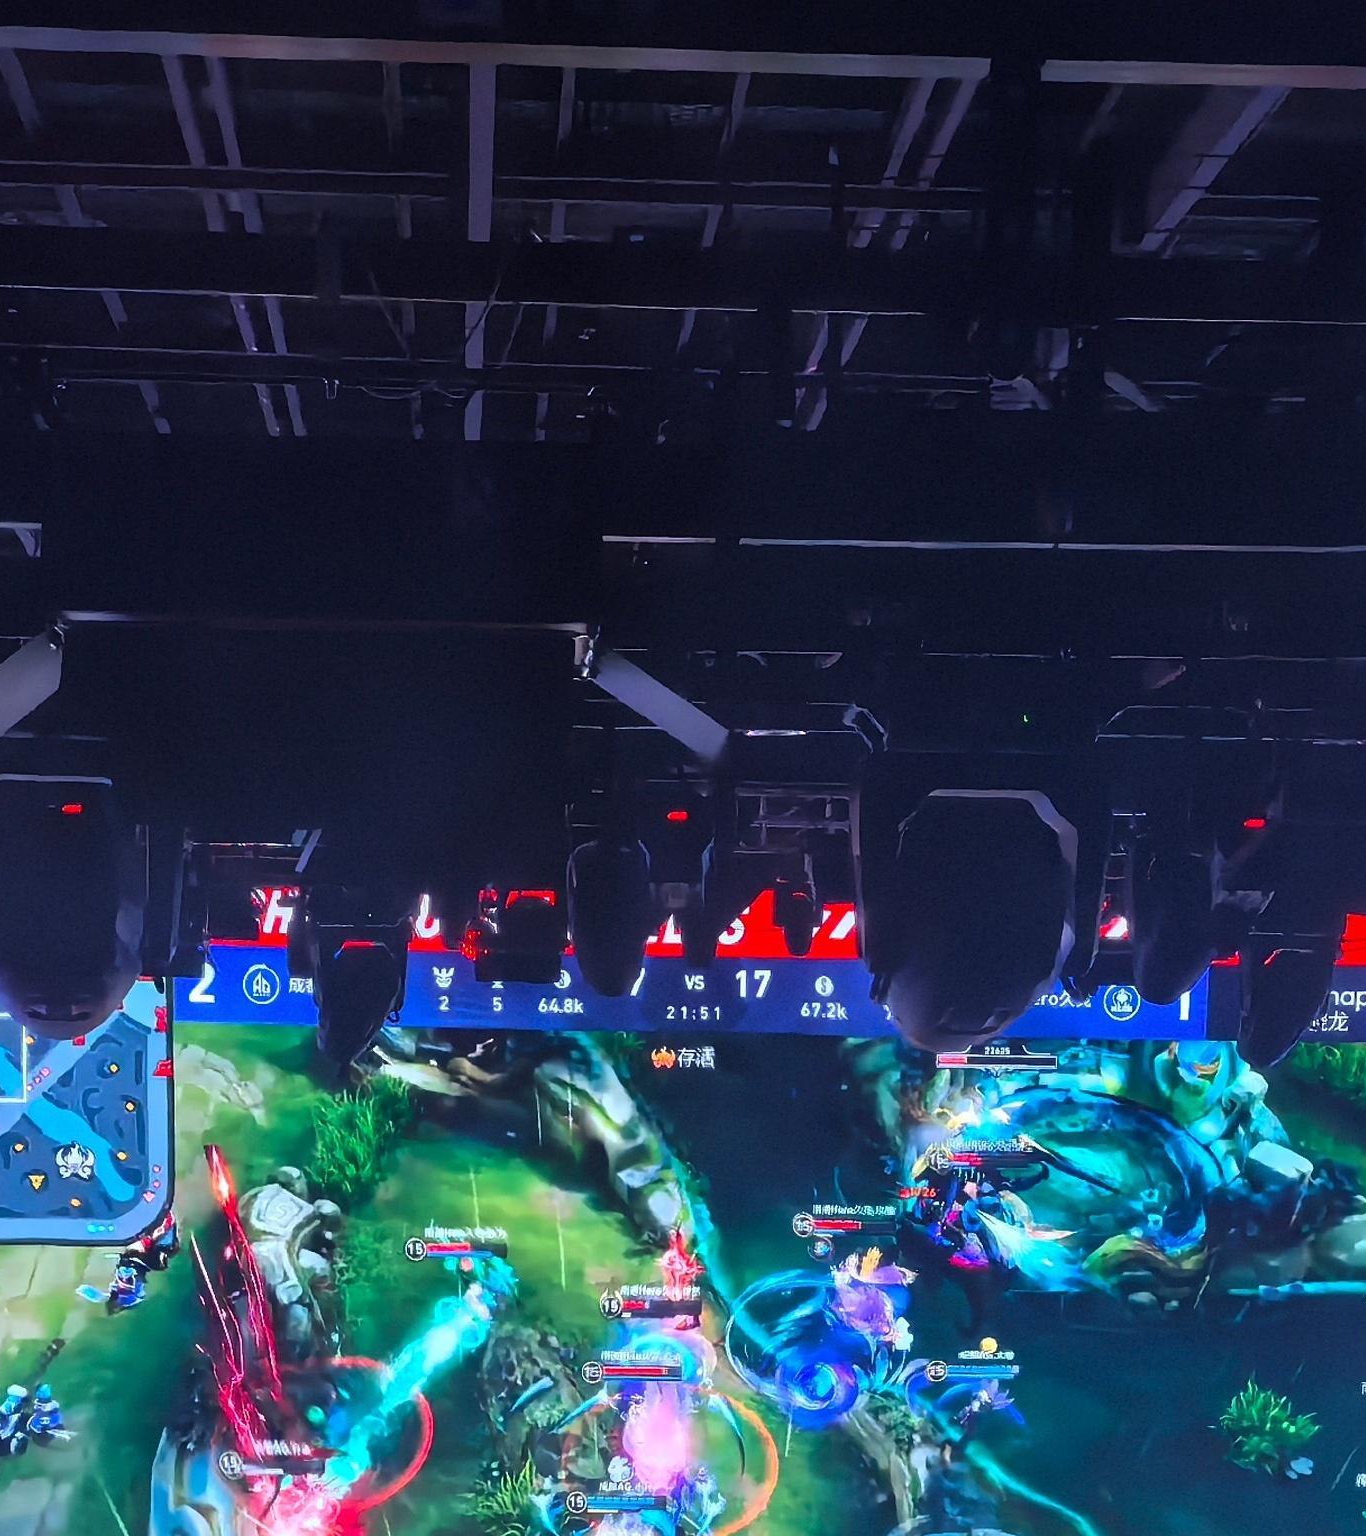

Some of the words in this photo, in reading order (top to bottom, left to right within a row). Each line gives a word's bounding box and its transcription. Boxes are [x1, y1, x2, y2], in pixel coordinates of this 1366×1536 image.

[189, 962, 216, 1003] 2
[685, 975, 706, 991] VS
[735, 970, 773, 998] 17
[438, 996, 450, 1012] 2
[492, 996, 503, 1012] 5
[538, 998, 584, 1014] 64.8k
[800, 1002, 848, 1020] 67.2k
[666, 1005, 721, 1021] 21:51
